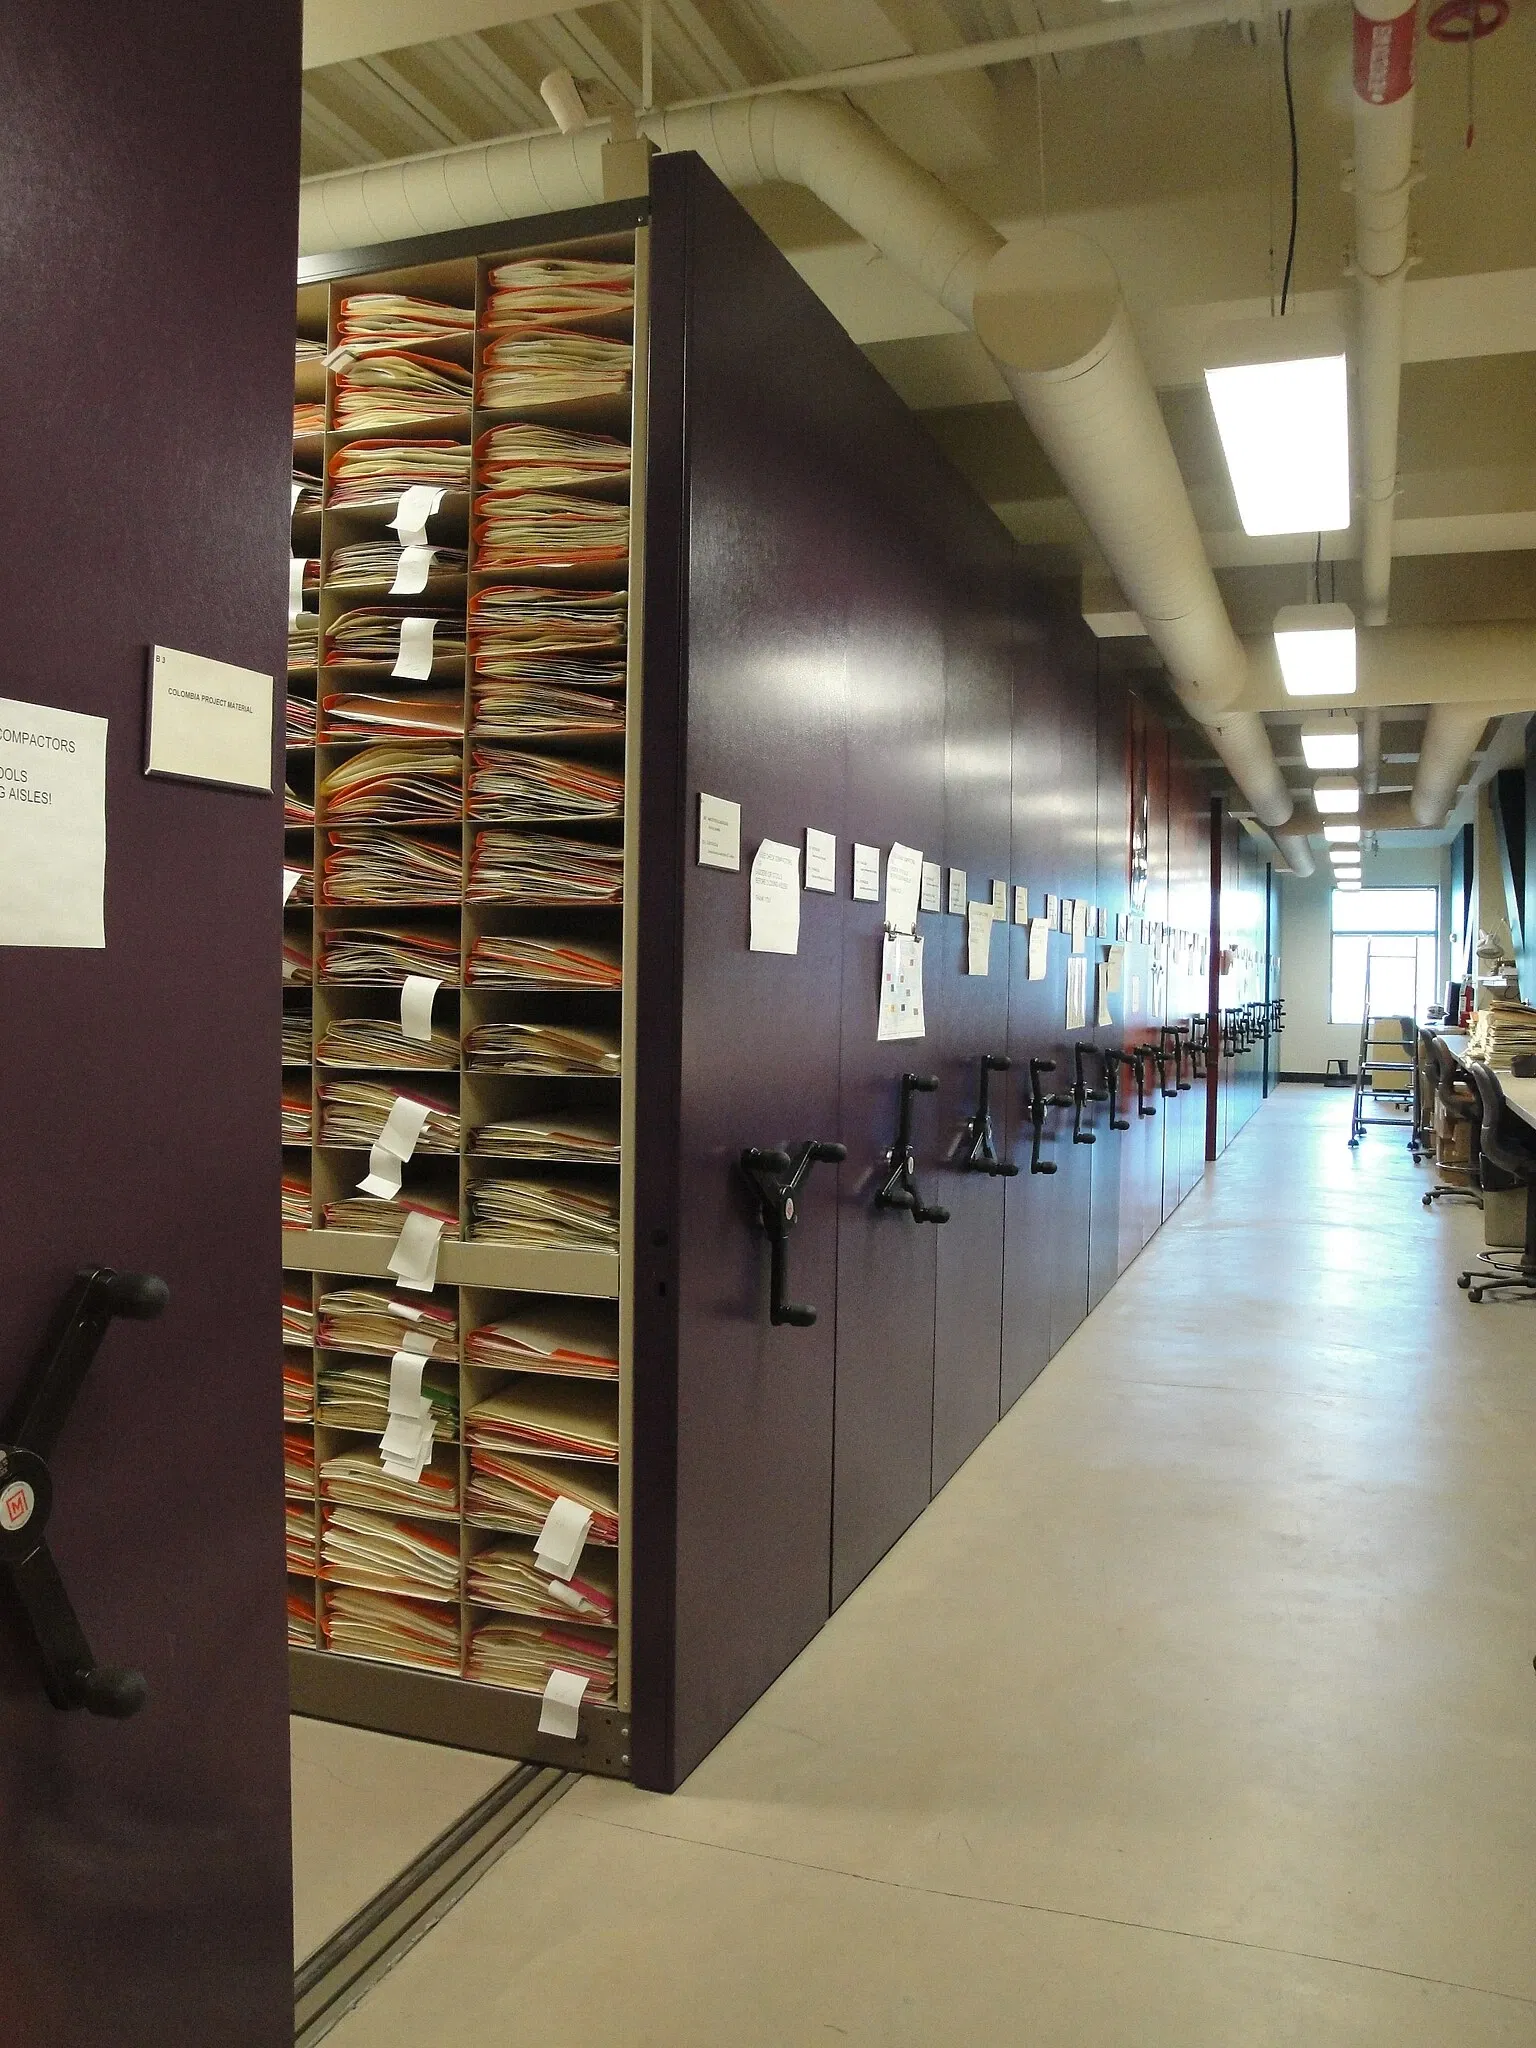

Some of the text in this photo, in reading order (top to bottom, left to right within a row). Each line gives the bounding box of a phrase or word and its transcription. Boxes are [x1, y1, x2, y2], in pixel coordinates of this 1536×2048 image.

[155, 654, 166, 664] B 3
[167, 687, 254, 714] COLOMBIA PROJECT MATERIAL
[0, 728, 76, 753] OMPACTORS
[8, 787, 52, 805] AISLES!
